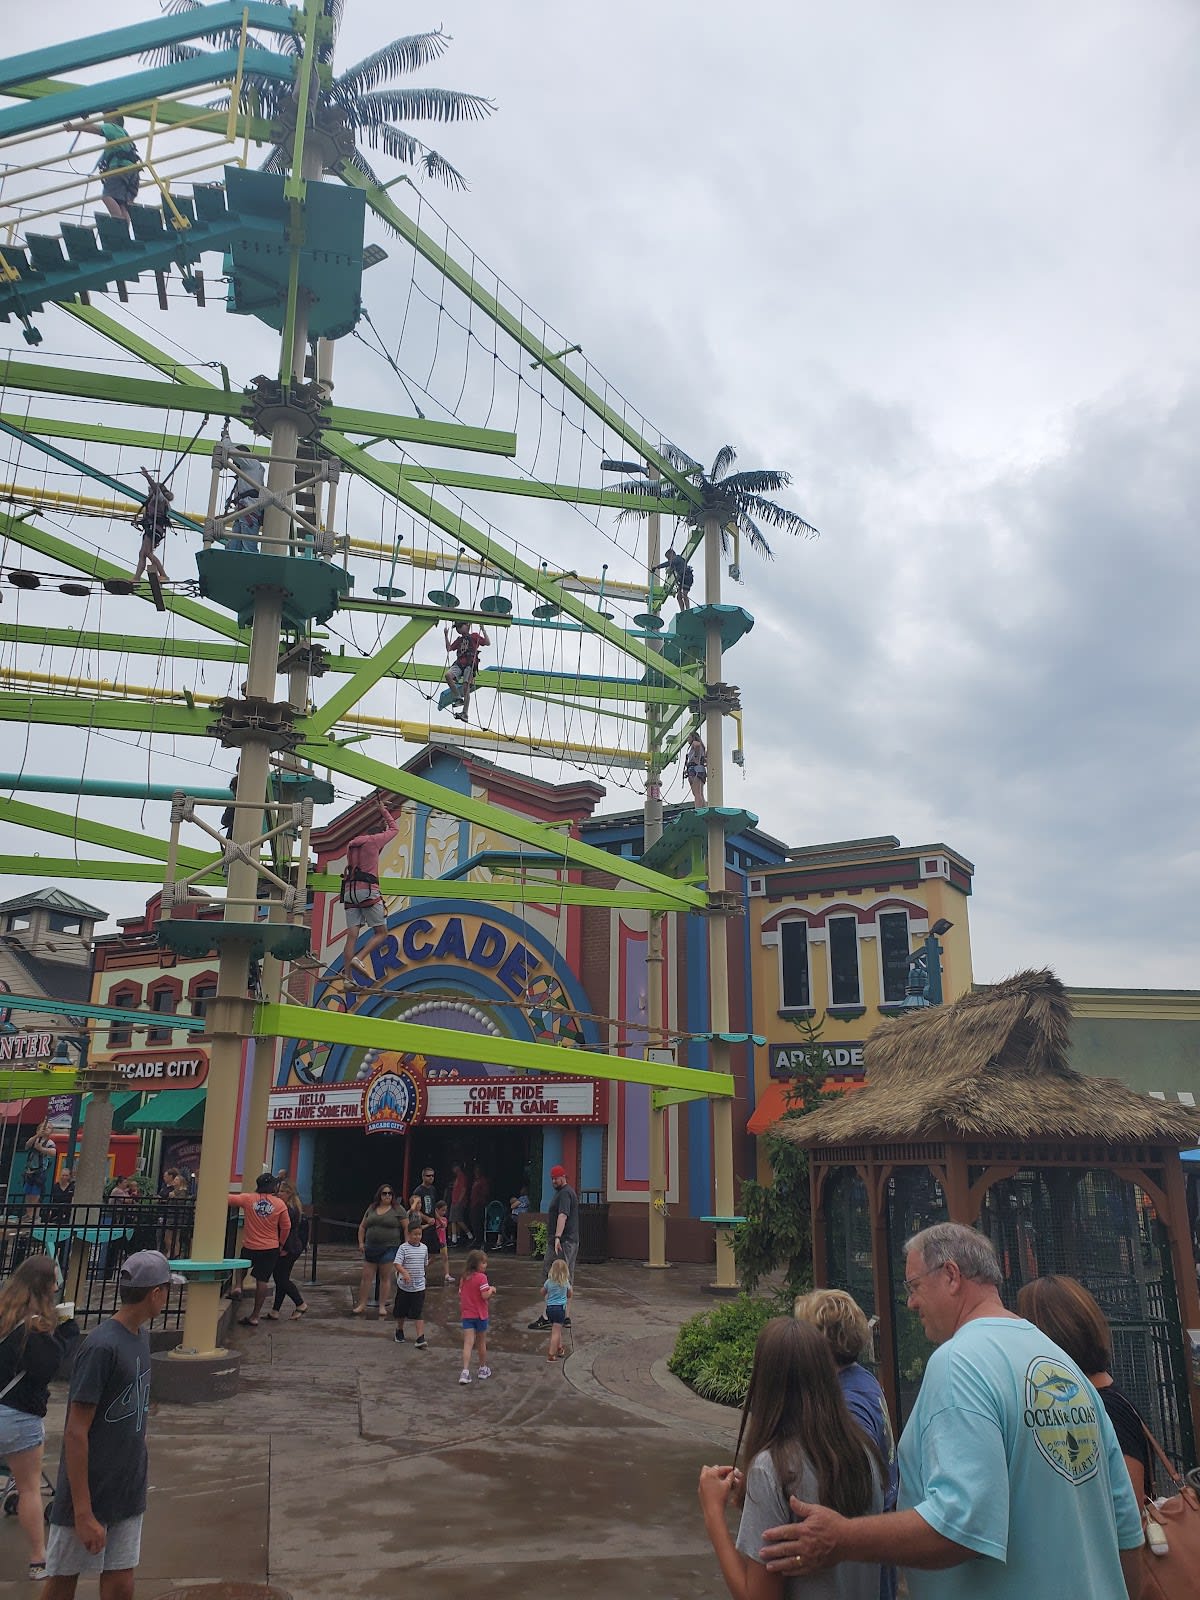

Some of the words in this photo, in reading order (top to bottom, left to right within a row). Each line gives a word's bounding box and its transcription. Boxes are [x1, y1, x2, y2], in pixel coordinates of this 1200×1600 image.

[113, 1061, 164, 1079] RCADE
[167, 1059, 200, 1077] CITY
[299, 1093, 326, 1106] HELLO
[469, 1086, 506, 1100] COME
[512, 1085, 544, 1099] RIDE
[273, 1108, 293, 1119] LETS
[294, 1106, 315, 1119] HAVE
[316, 1105, 340, 1117] SOME
[340, 1104, 359, 1117] FUN
[464, 1100, 490, 1114] THE
[497, 1100, 514, 1114] VR
[520, 1099, 559, 1114] GAME
[368, 1122, 390, 1131] ARCADE
[390, 1122, 404, 1130] CITY
